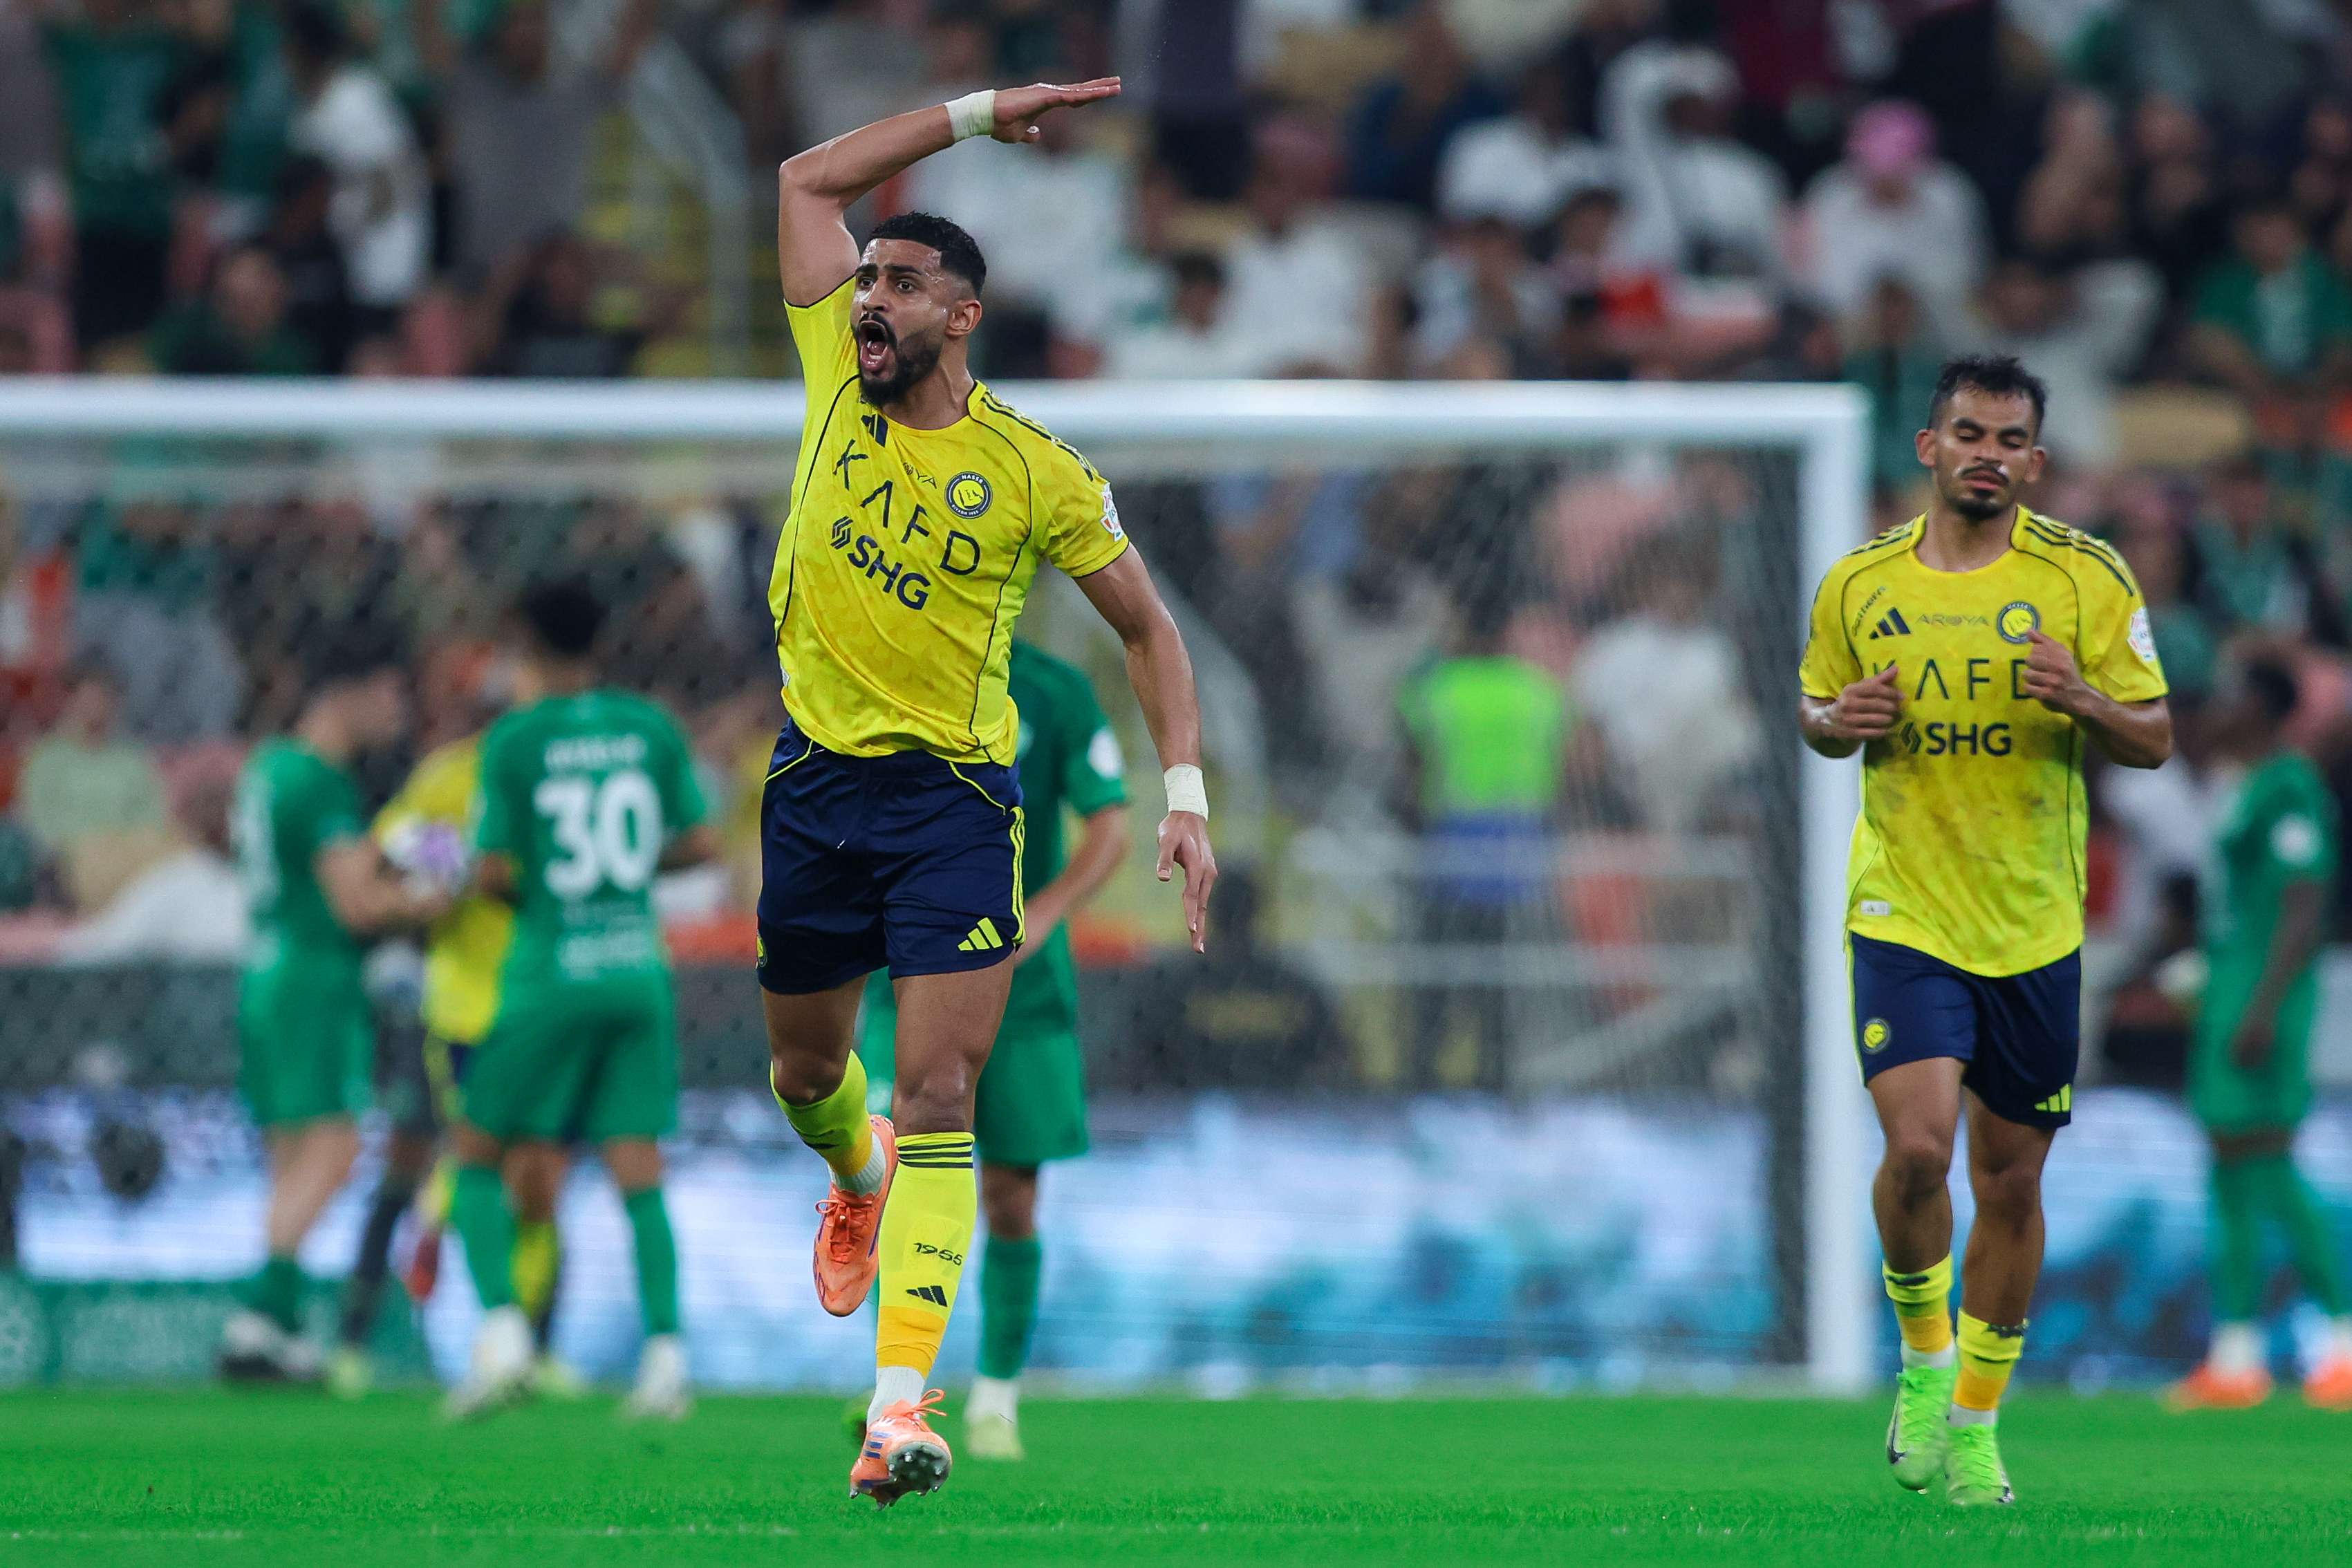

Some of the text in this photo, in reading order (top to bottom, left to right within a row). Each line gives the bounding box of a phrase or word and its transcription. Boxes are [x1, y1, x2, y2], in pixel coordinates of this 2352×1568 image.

[832, 438, 981, 576] KAFD
[847, 534, 931, 610] SHG
[1925, 722, 2012, 756] SHG
[534, 772, 666, 898] 30
[913, 1242, 963, 1266] 1955
